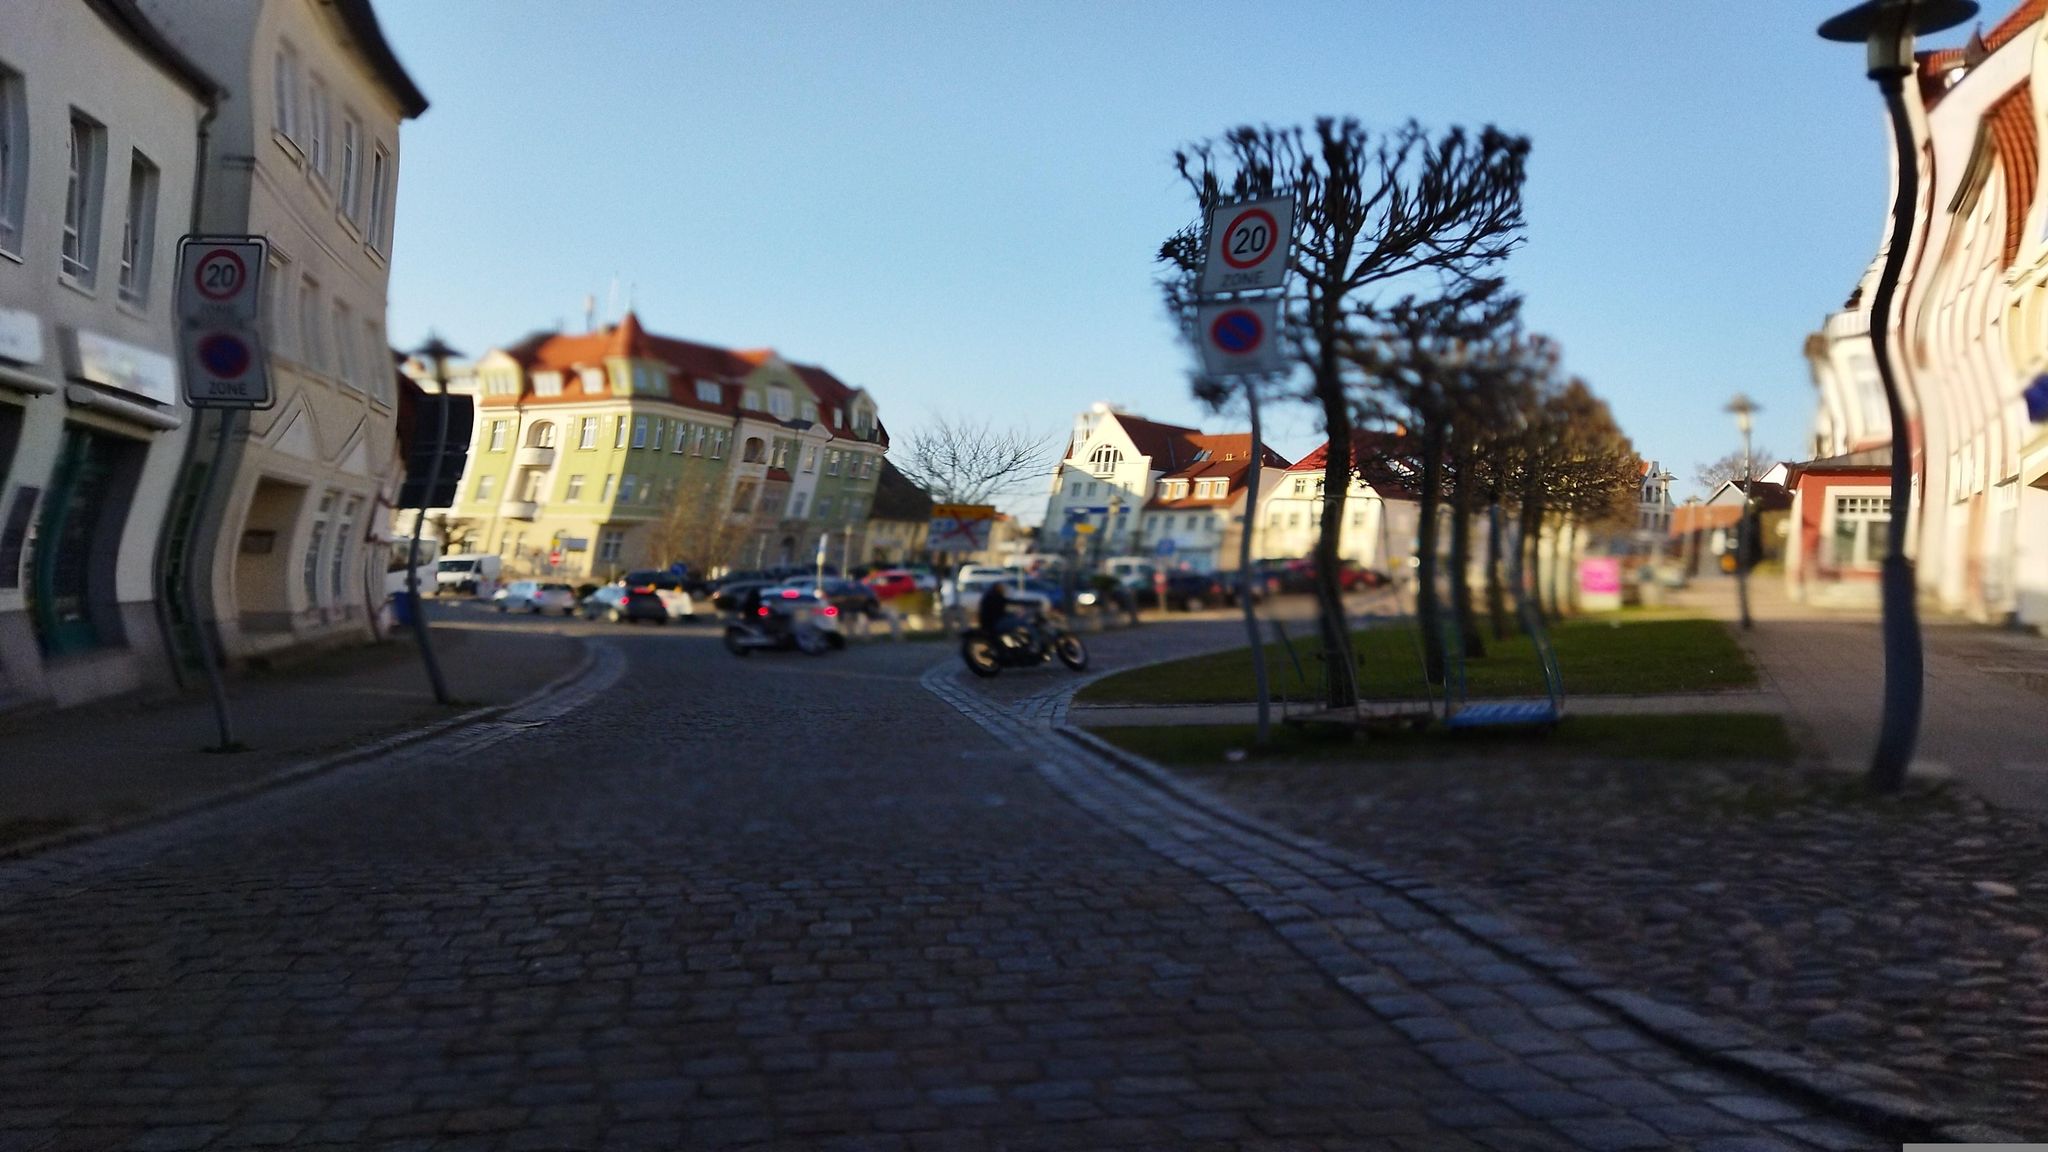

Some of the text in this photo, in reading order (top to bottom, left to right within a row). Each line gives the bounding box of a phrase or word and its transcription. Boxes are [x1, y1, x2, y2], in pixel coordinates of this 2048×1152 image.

[1234, 226, 1267, 255] 20
[206, 264, 235, 287] 20
[1221, 271, 1265, 288] ZONE
[208, 381, 248, 396] ZONE
